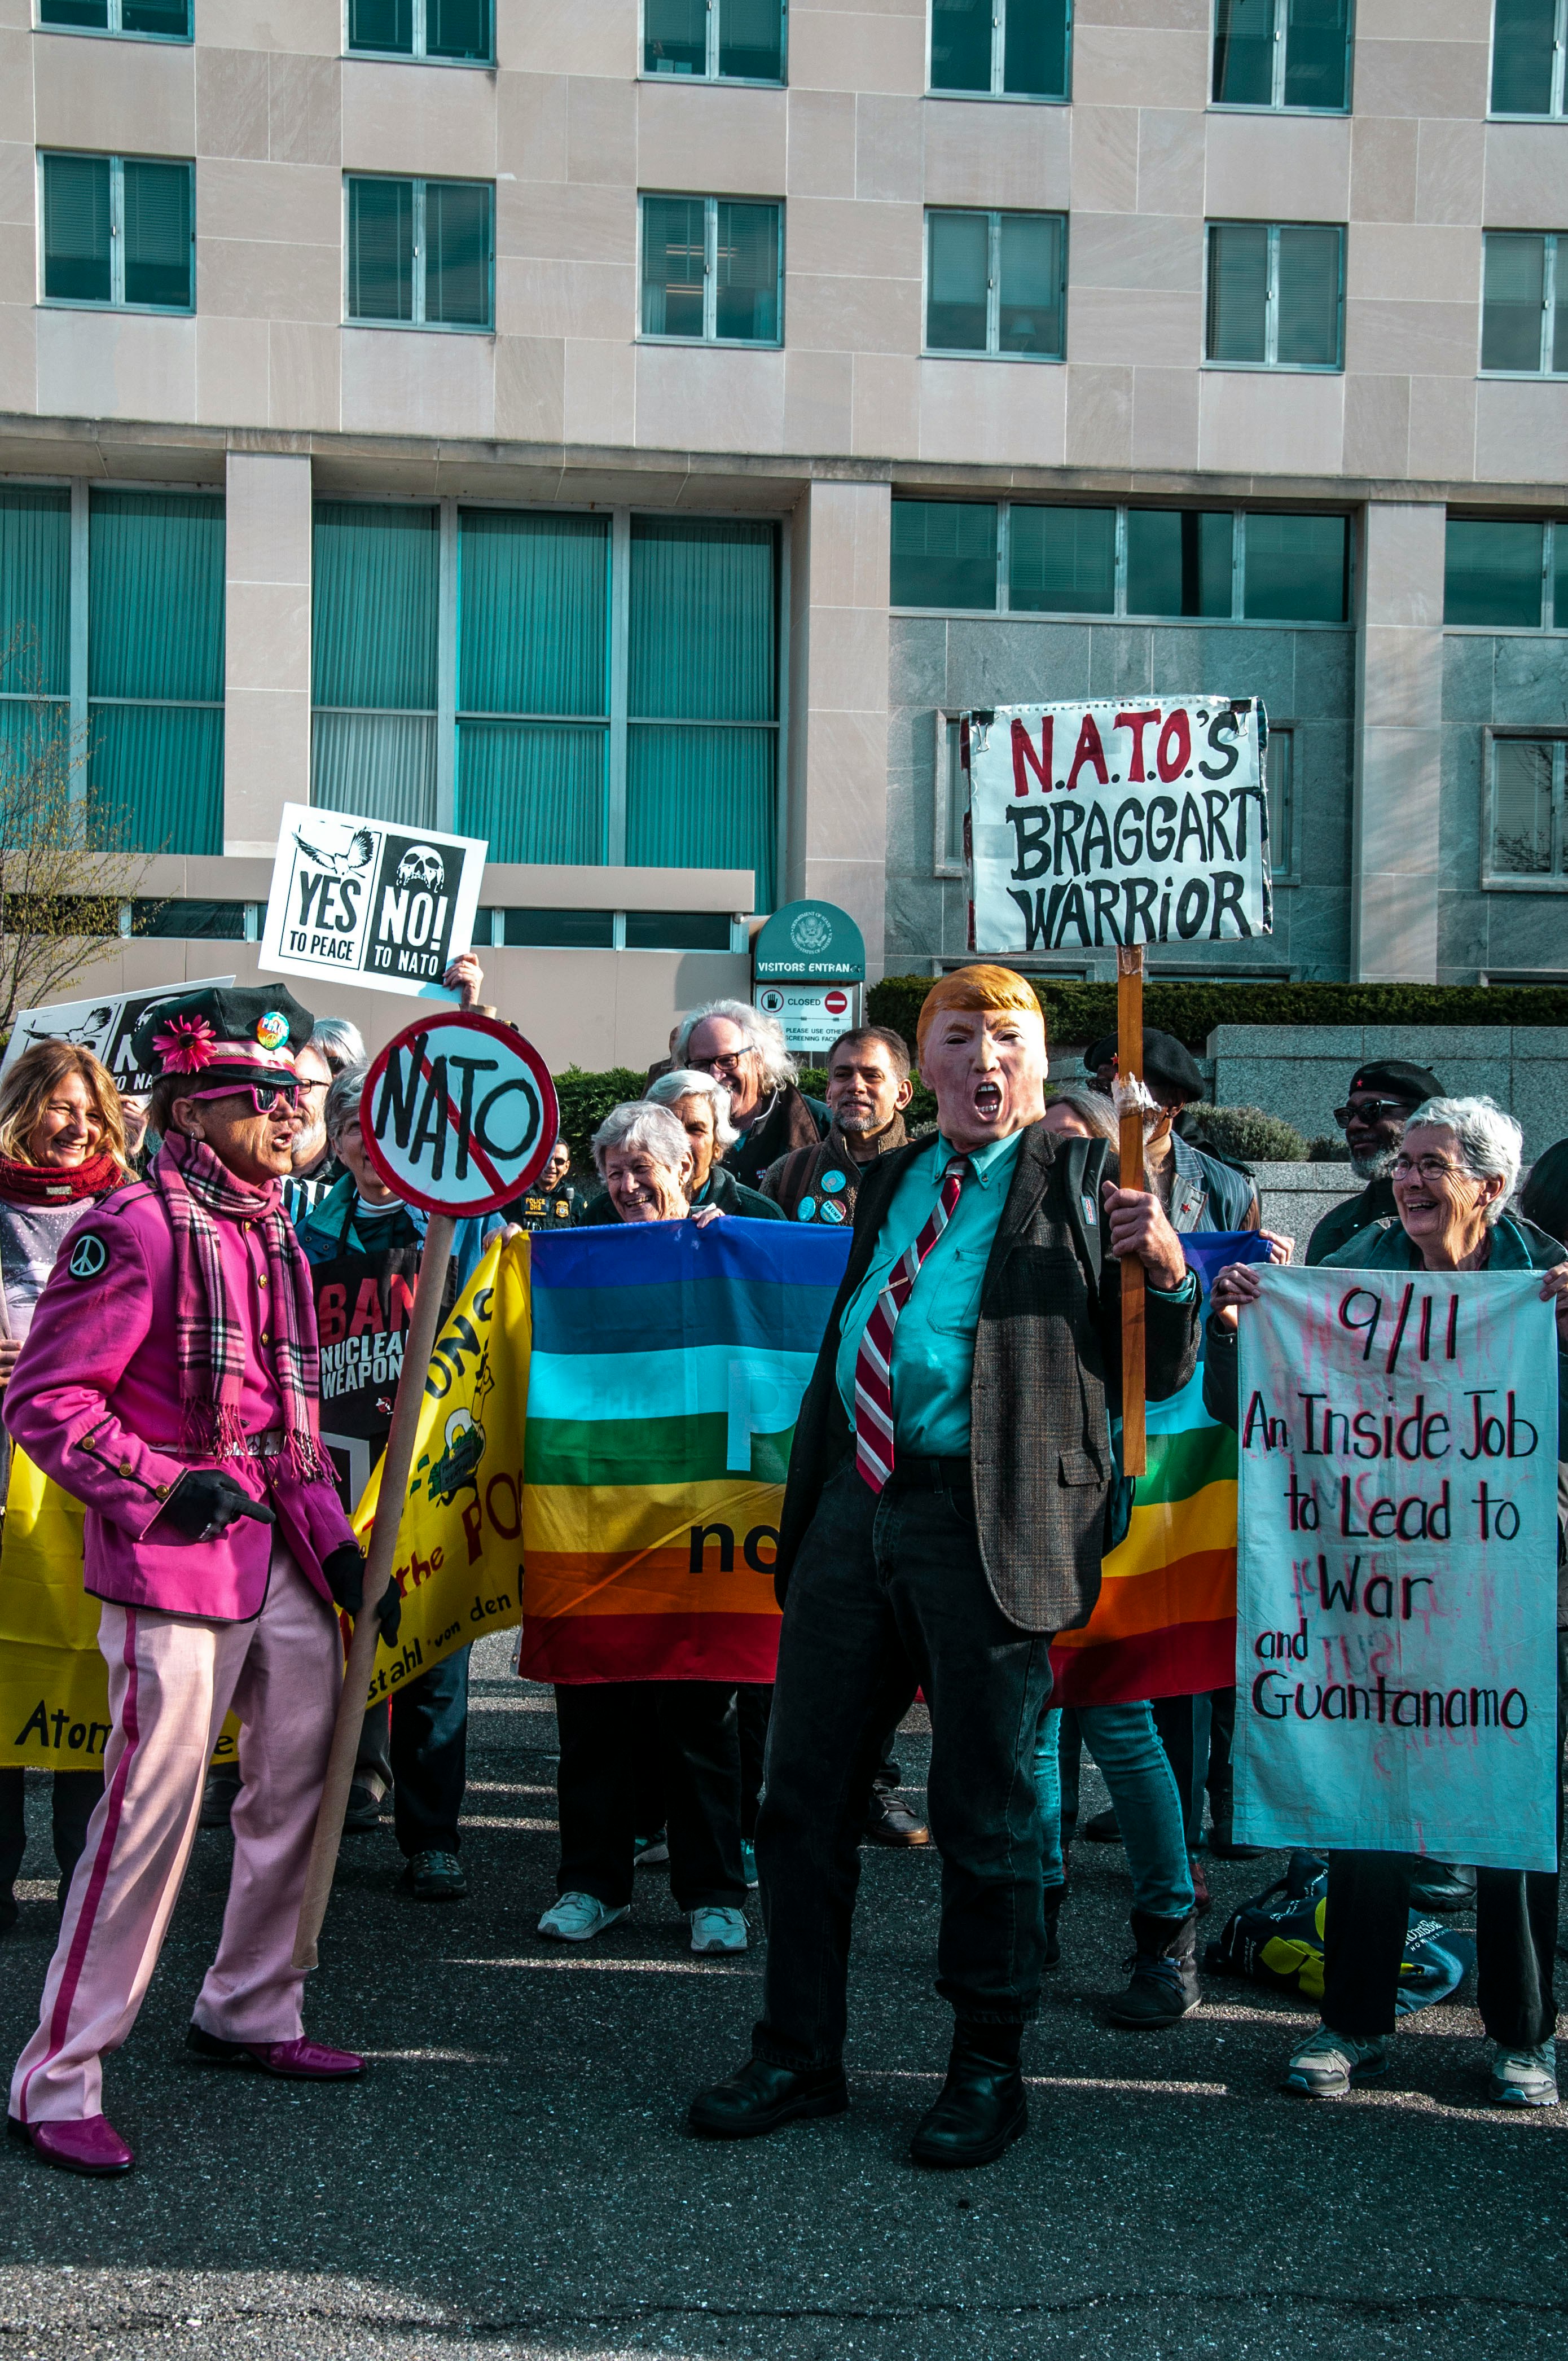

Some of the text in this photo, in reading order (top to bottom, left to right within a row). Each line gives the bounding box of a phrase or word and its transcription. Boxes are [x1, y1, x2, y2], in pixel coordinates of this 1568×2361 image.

[1005, 786, 1264, 880] BRAGGART
[299, 871, 362, 933] YES
[379, 887, 449, 951] NO!
[290, 931, 355, 961] TO PEACE
[375, 945, 439, 976] TO NATO
[758, 962, 805, 972] VISITORS
[374, 1032, 541, 1180] NATO
[825, 1202, 841, 1219] TRUMP
[320, 1329, 410, 1376] NUCLEA
[1338, 1283, 1459, 1373] 9/11
[1242, 1389, 1538, 1460] An Inside Job
[1284, 1473, 1521, 1542] to Lead to
[469, 1594, 512, 1622] den
[1317, 1553, 1434, 1620] War
[1254, 1617, 1308, 1661] and
[1251, 1670, 1529, 1730] Guantanamo
